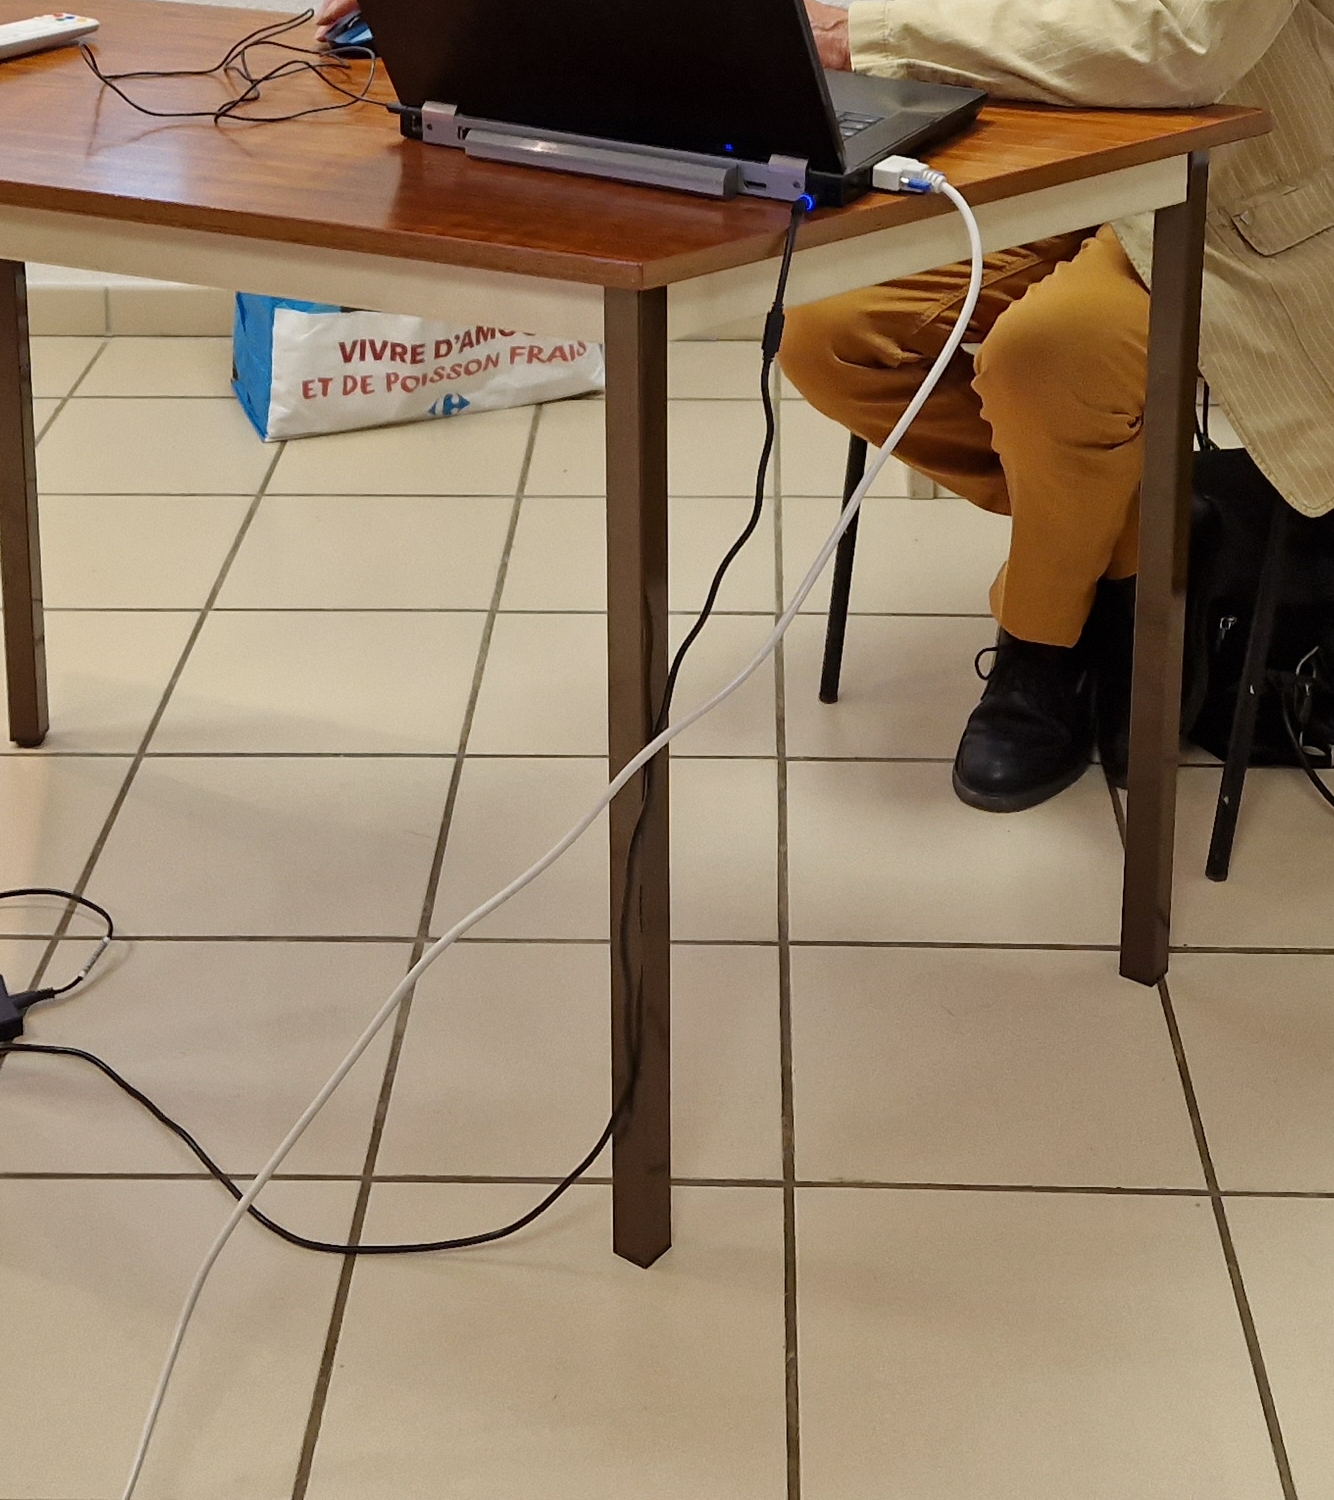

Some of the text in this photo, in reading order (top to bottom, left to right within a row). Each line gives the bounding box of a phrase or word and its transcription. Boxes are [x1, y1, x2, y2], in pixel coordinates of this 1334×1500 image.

[338, 325, 536, 365] VIVRE D'AM
[301, 377, 334, 400] ET
[341, 374, 375, 396] DE
[385, 351, 501, 394] POISSON
